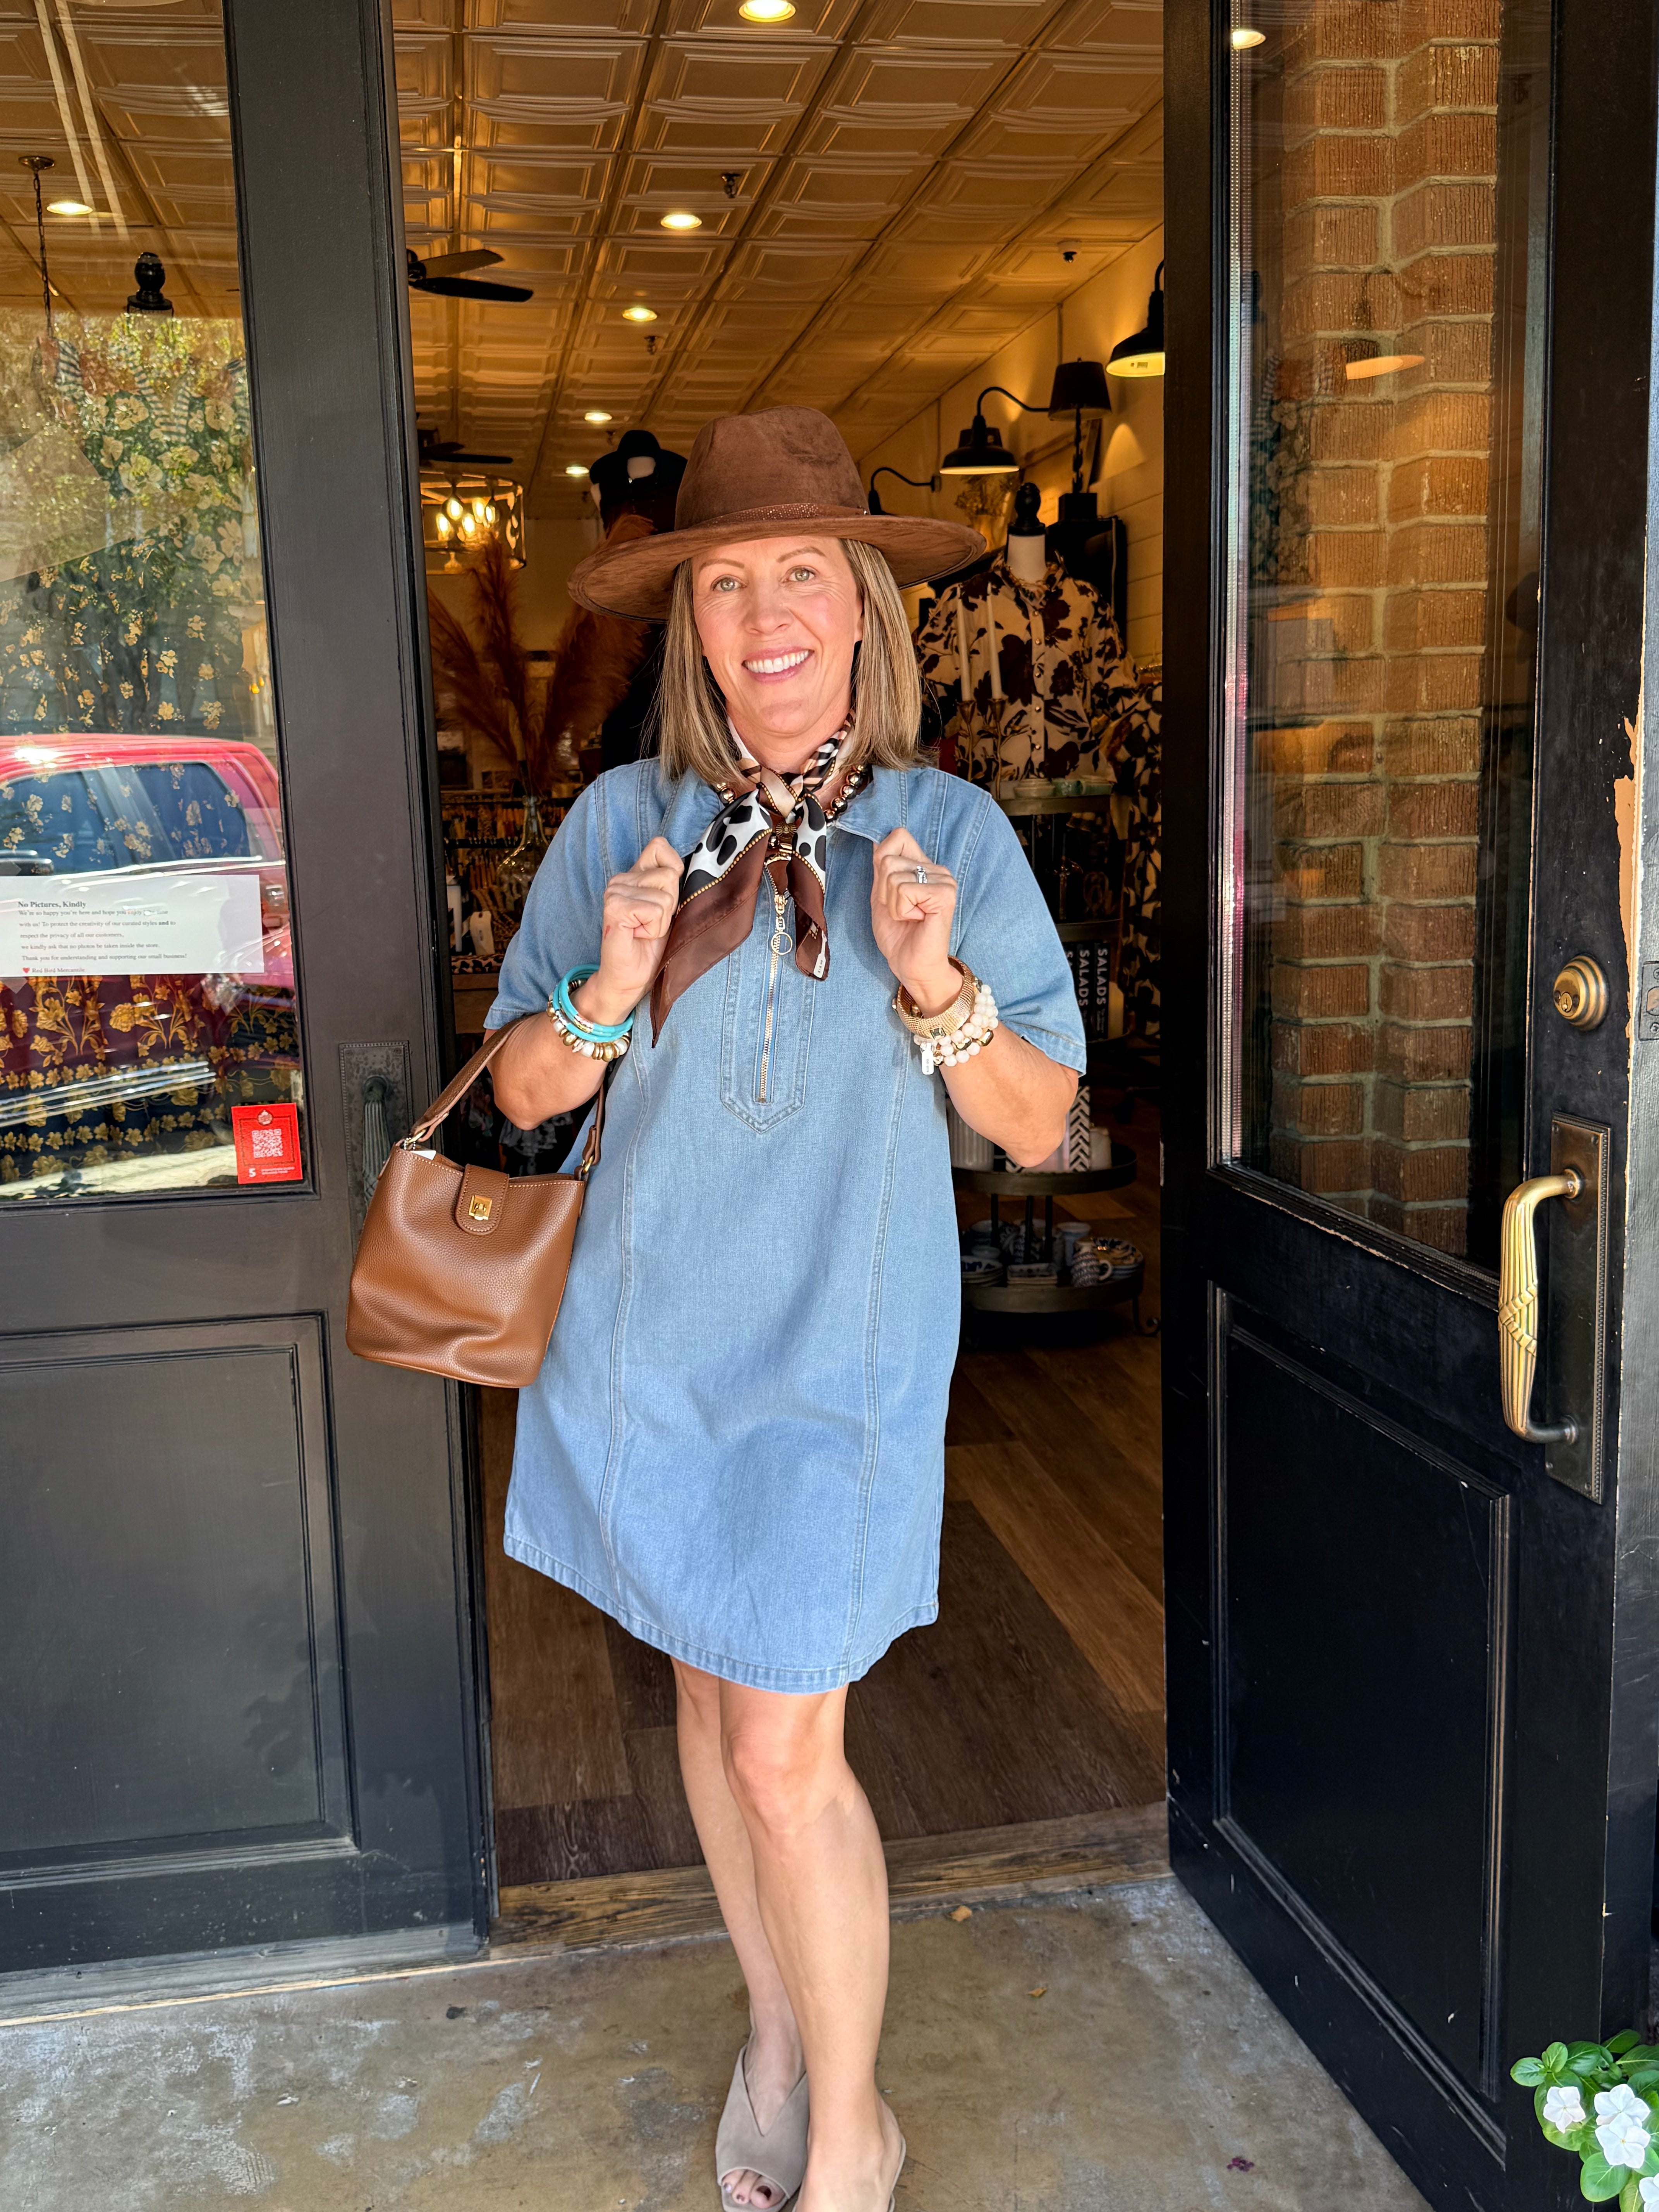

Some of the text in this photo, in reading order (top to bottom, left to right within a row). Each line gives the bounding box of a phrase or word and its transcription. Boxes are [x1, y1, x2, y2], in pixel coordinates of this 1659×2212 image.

[1079, 950, 1090, 1006] SALADS
[1097, 948, 1108, 1005] SALADS
[249, 1168, 256, 1177] 5
